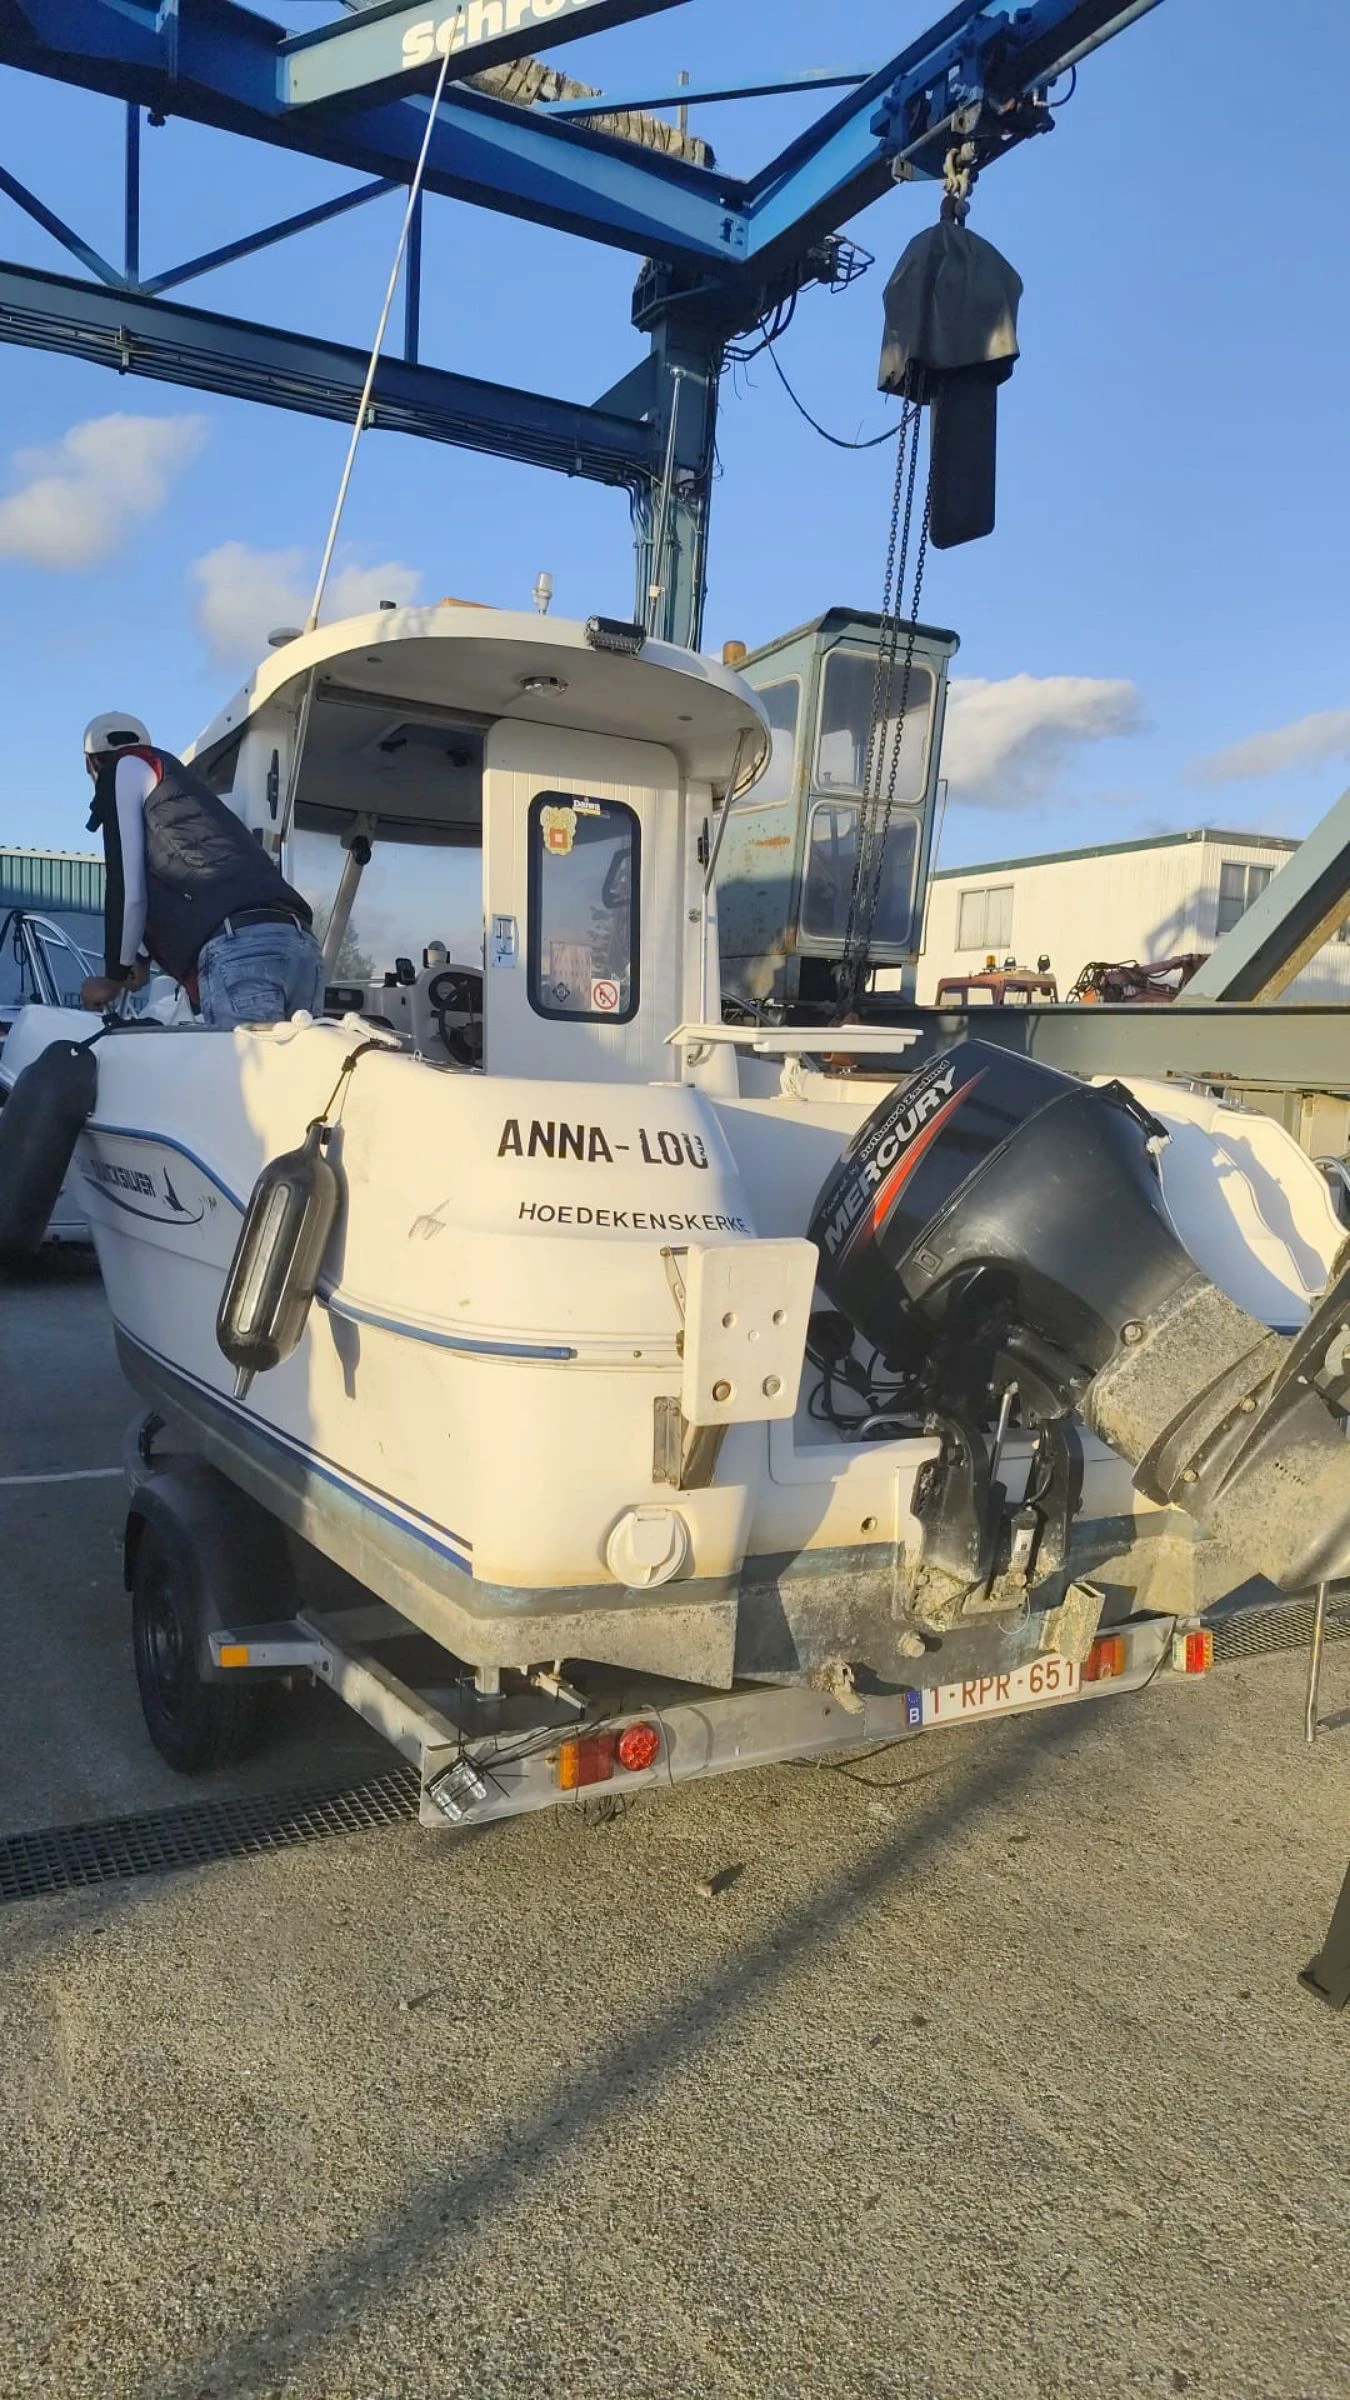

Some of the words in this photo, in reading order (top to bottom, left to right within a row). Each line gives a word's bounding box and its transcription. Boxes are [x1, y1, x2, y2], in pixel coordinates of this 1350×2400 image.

[824, 1066, 956, 1256] MERCURY
[518, 1201, 751, 1233] HOEDEKENSKERKE
[909, 1708, 920, 1724] B
